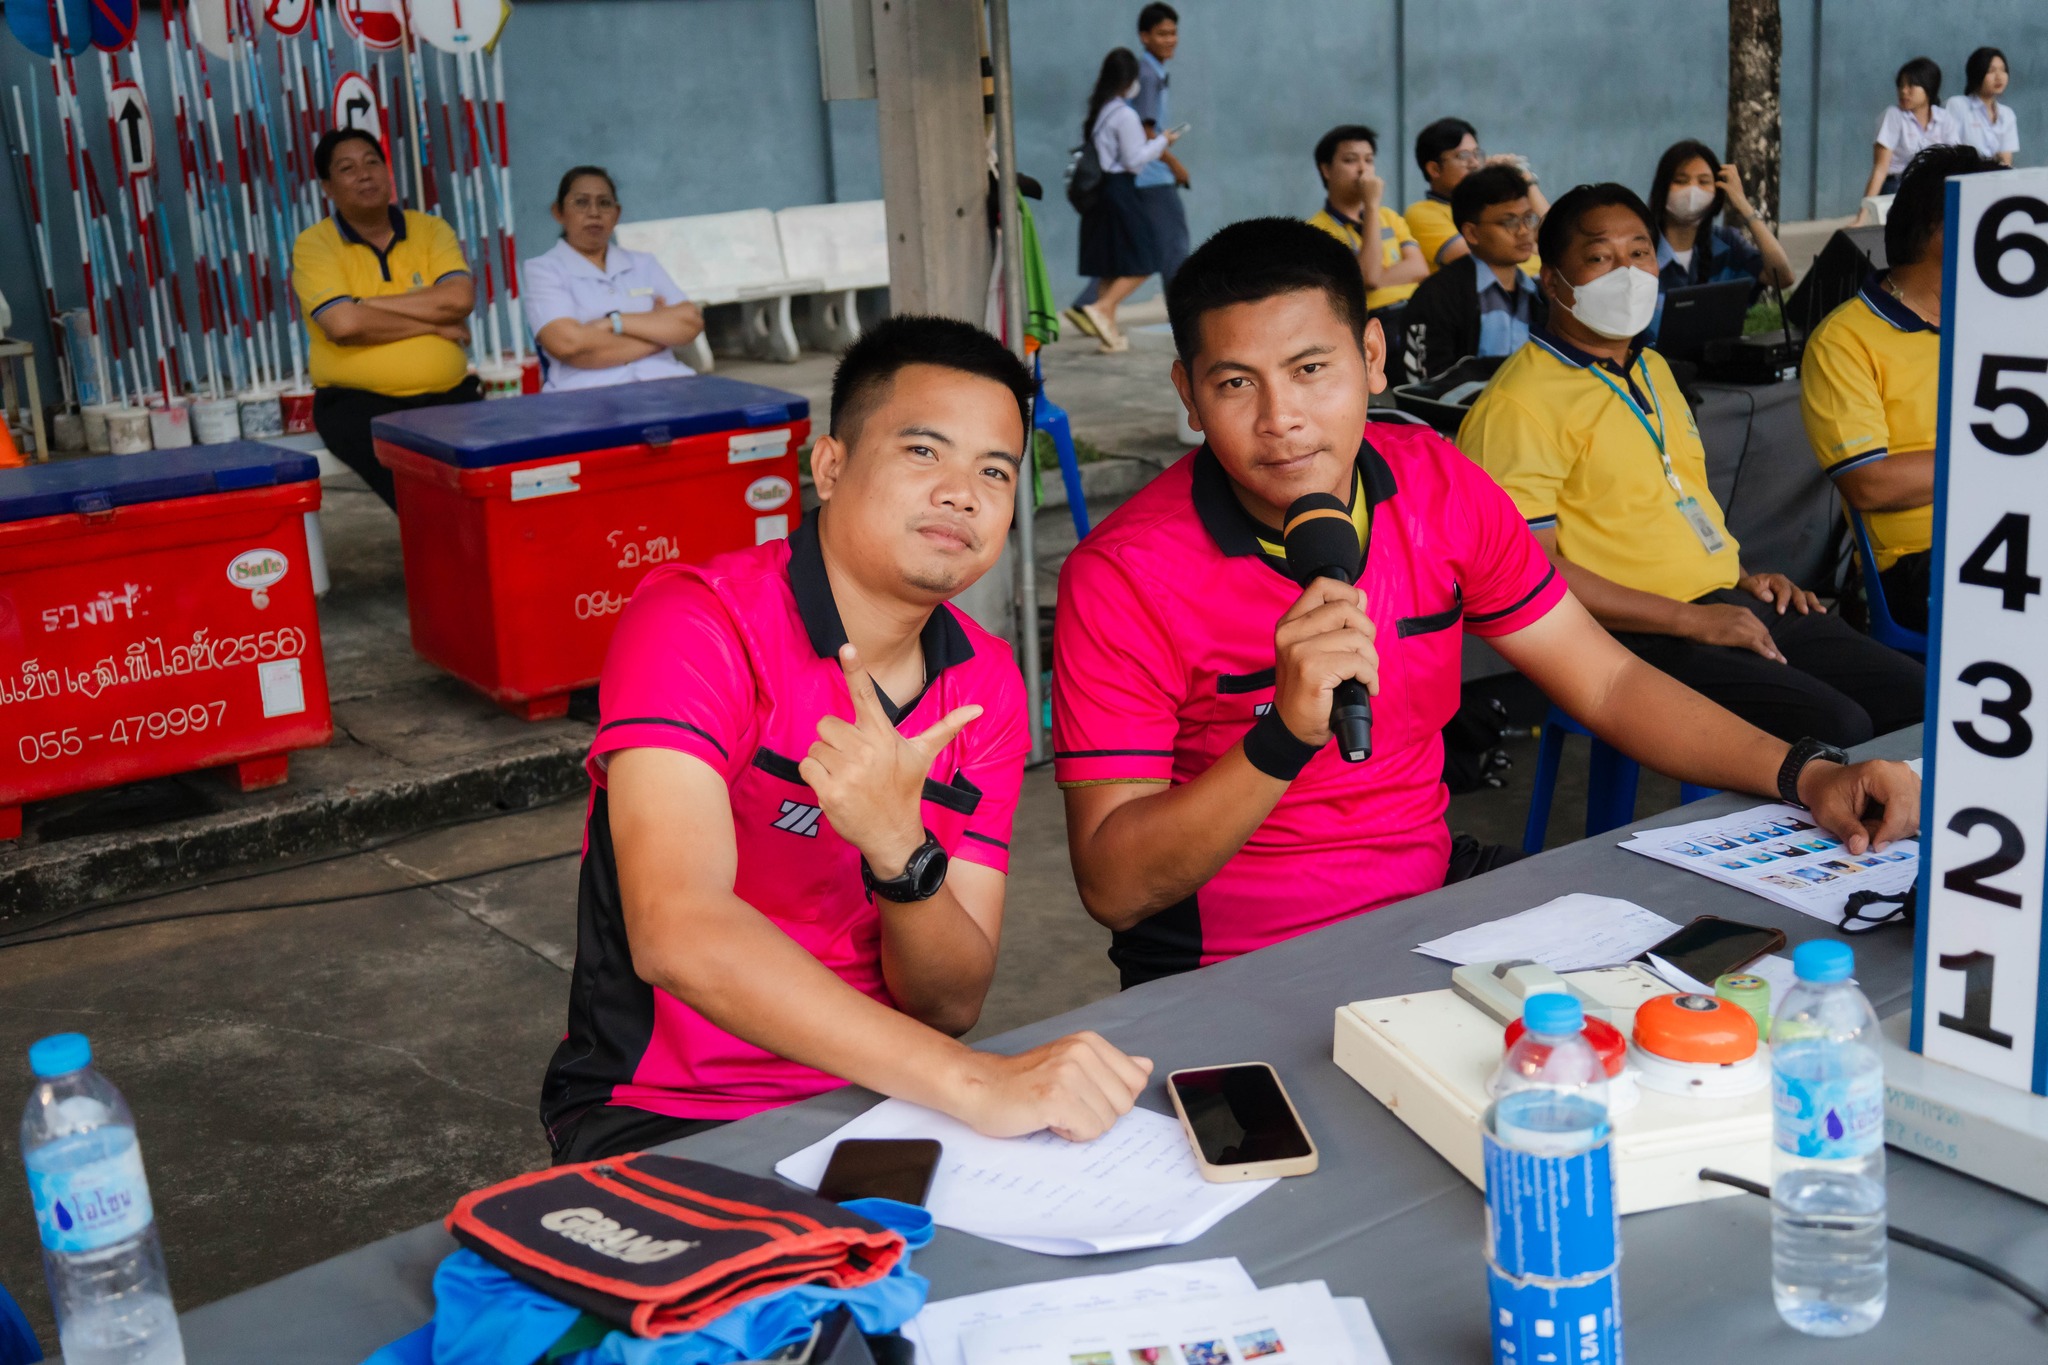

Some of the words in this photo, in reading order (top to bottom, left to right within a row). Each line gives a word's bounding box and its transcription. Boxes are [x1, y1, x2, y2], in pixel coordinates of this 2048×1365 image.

[1973, 195, 2048, 299] 6
[1969, 353, 2048, 456] 5
[234, 557, 284, 580] Safe
[1959, 511, 2042, 613] 4
[1951, 660, 2034, 759] 3
[1944, 806, 2026, 911] 2
[1938, 950, 2014, 1051] 1
